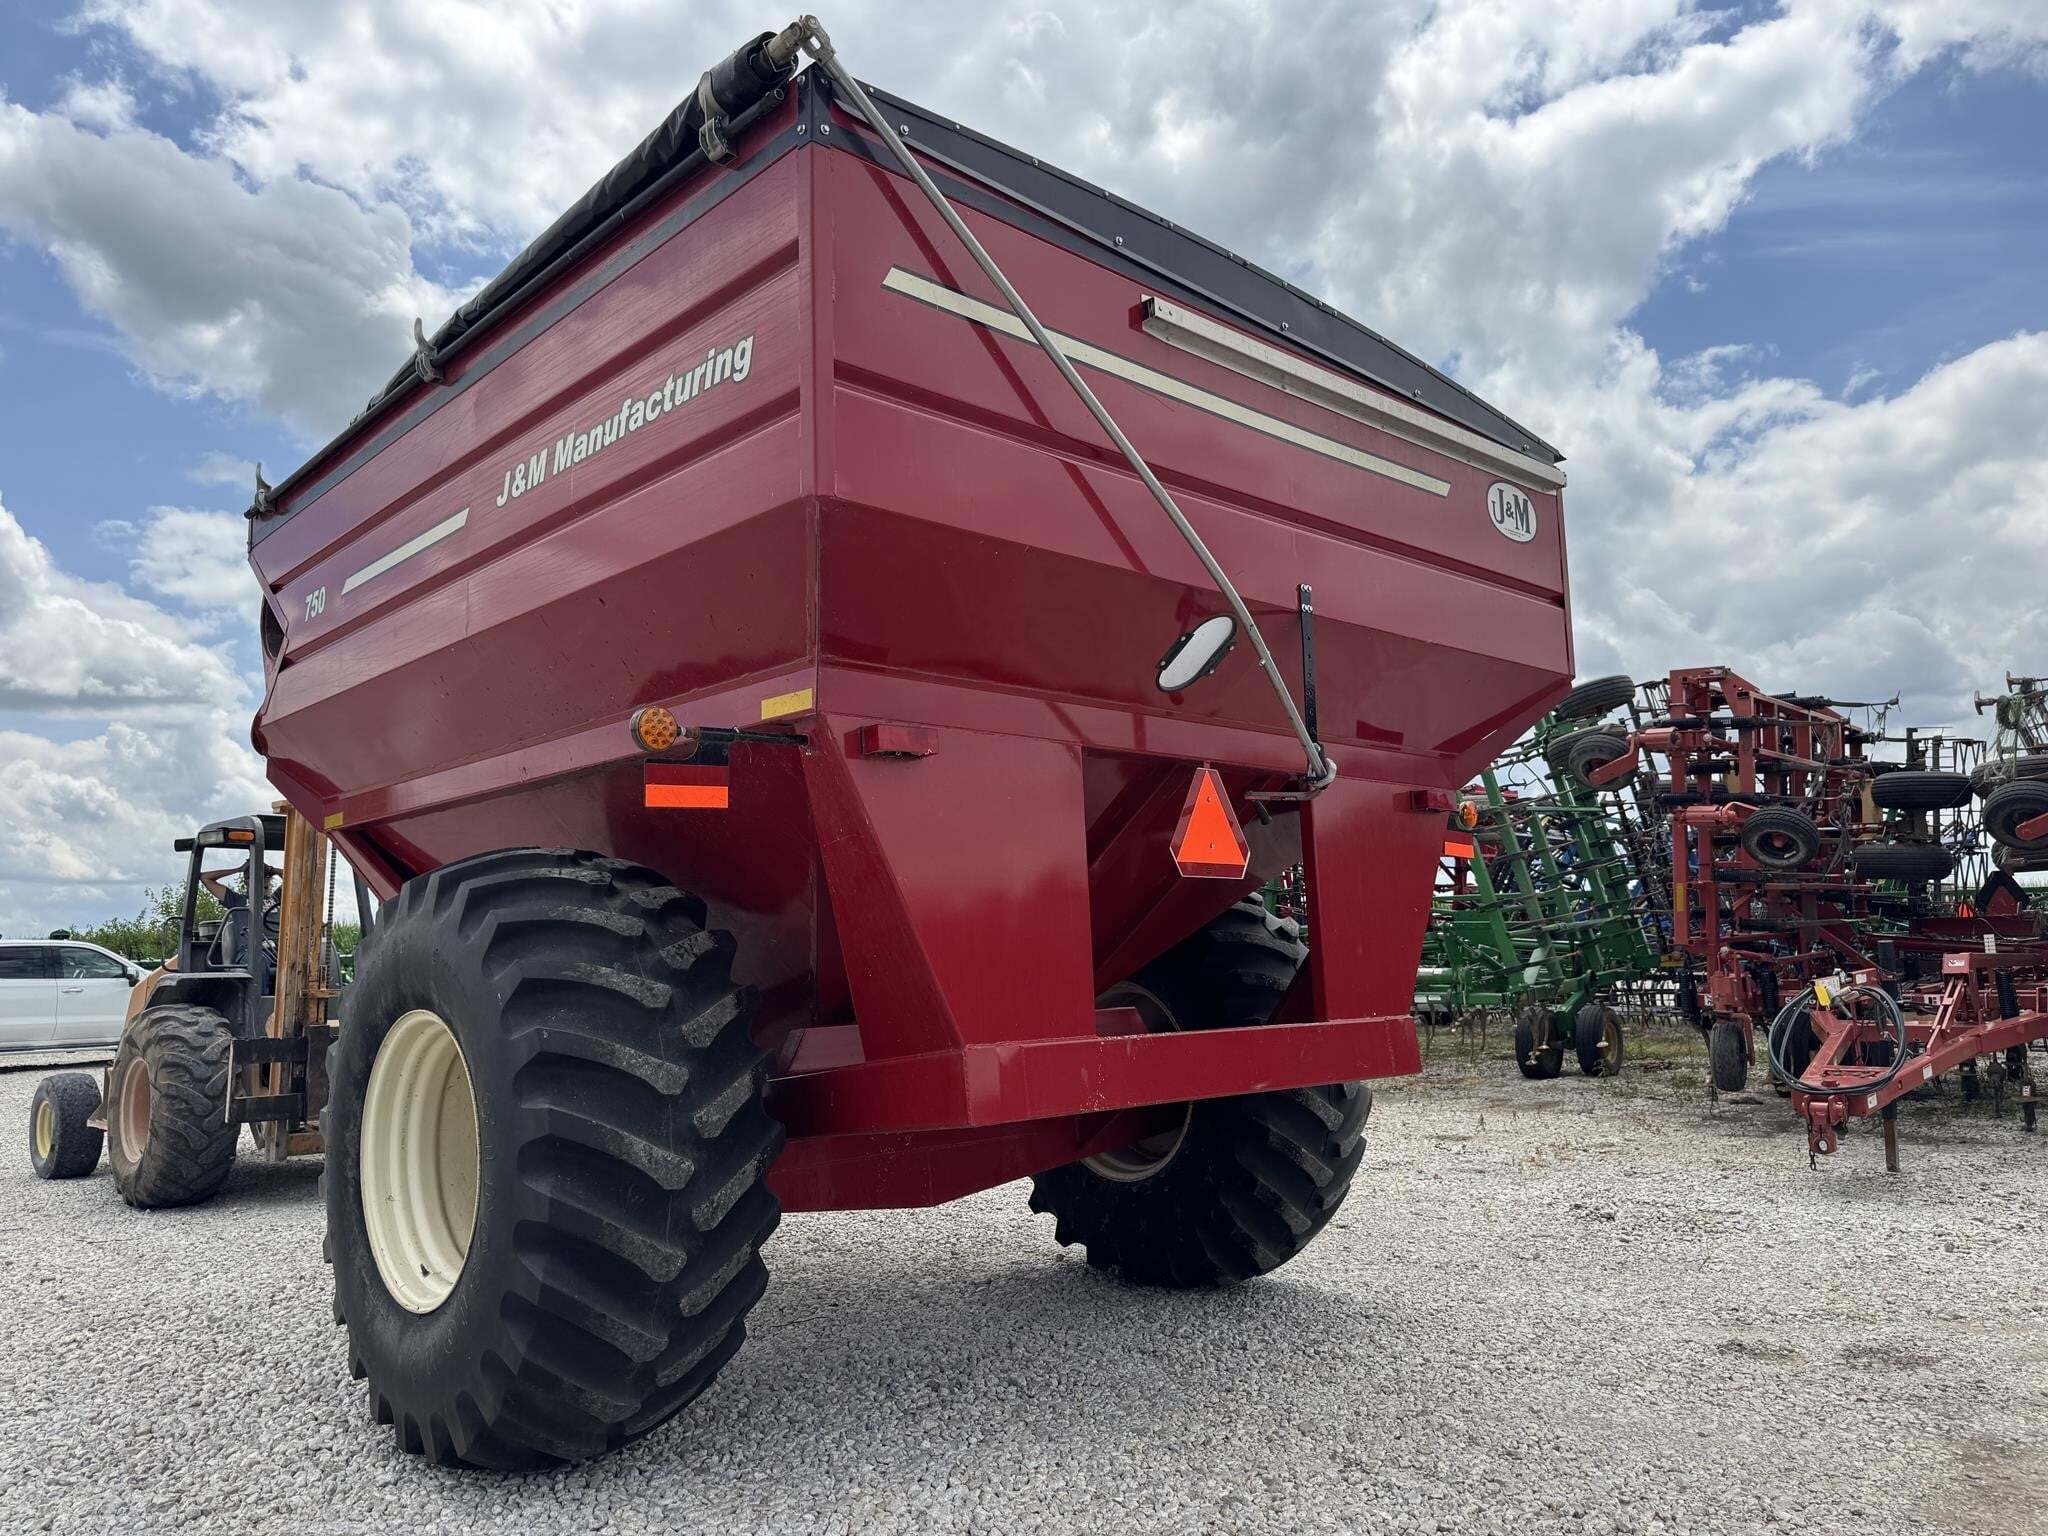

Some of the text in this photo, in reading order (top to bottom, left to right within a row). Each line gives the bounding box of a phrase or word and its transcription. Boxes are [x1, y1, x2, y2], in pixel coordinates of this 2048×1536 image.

[496, 335, 754, 507] J&M Manufacturing
[1491, 487, 1532, 535] J&M
[304, 585, 326, 623] 750
